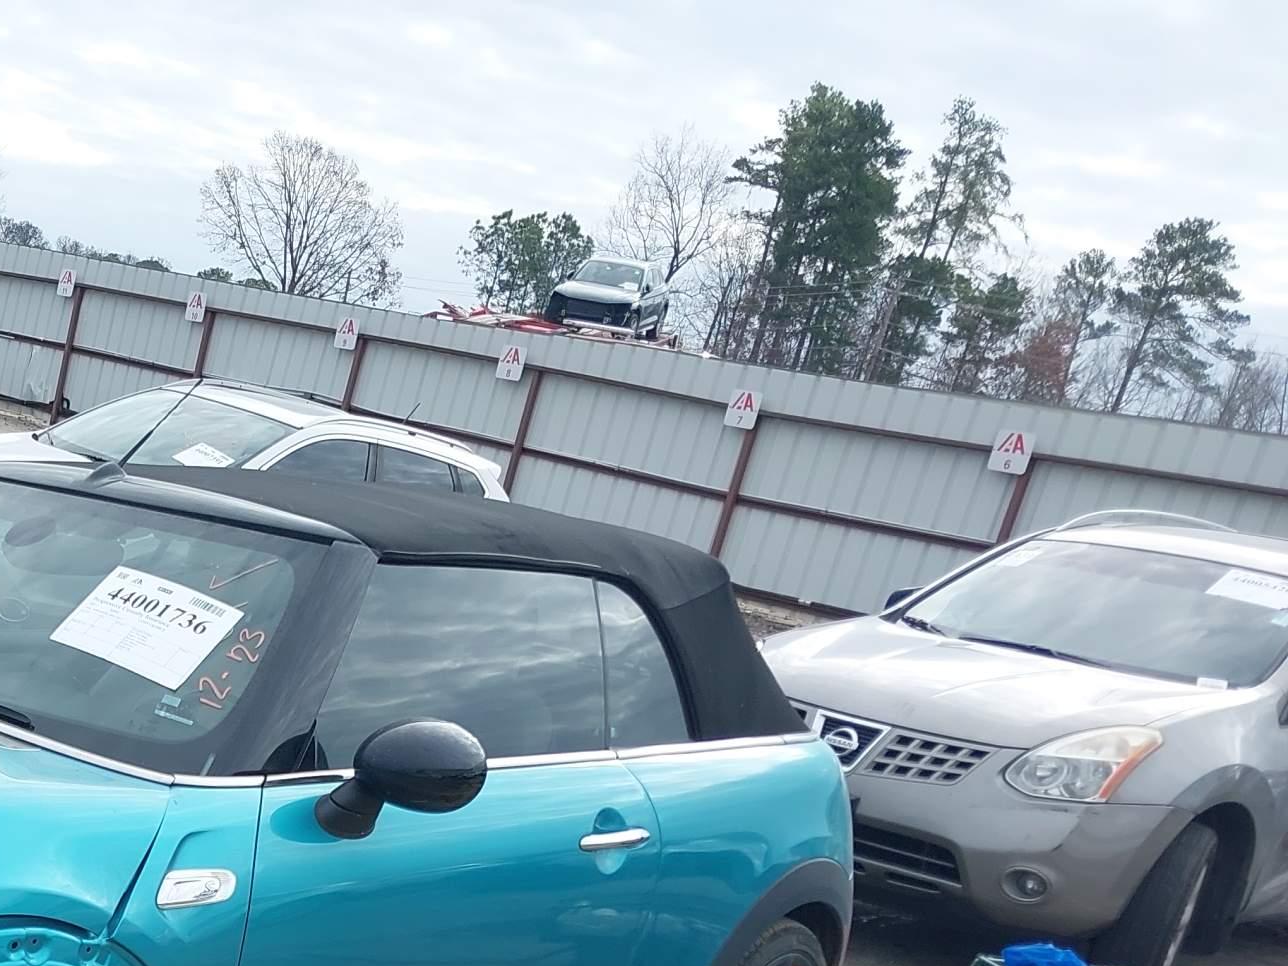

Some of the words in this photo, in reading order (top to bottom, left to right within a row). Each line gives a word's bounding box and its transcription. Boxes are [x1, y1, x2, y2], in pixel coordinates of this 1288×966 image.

[192, 312, 199, 320] 10
[505, 368, 512, 378] 8
[736, 415, 744, 425] 7
[1003, 459, 1012, 470] 6
[107, 587, 213, 636] 44001736
